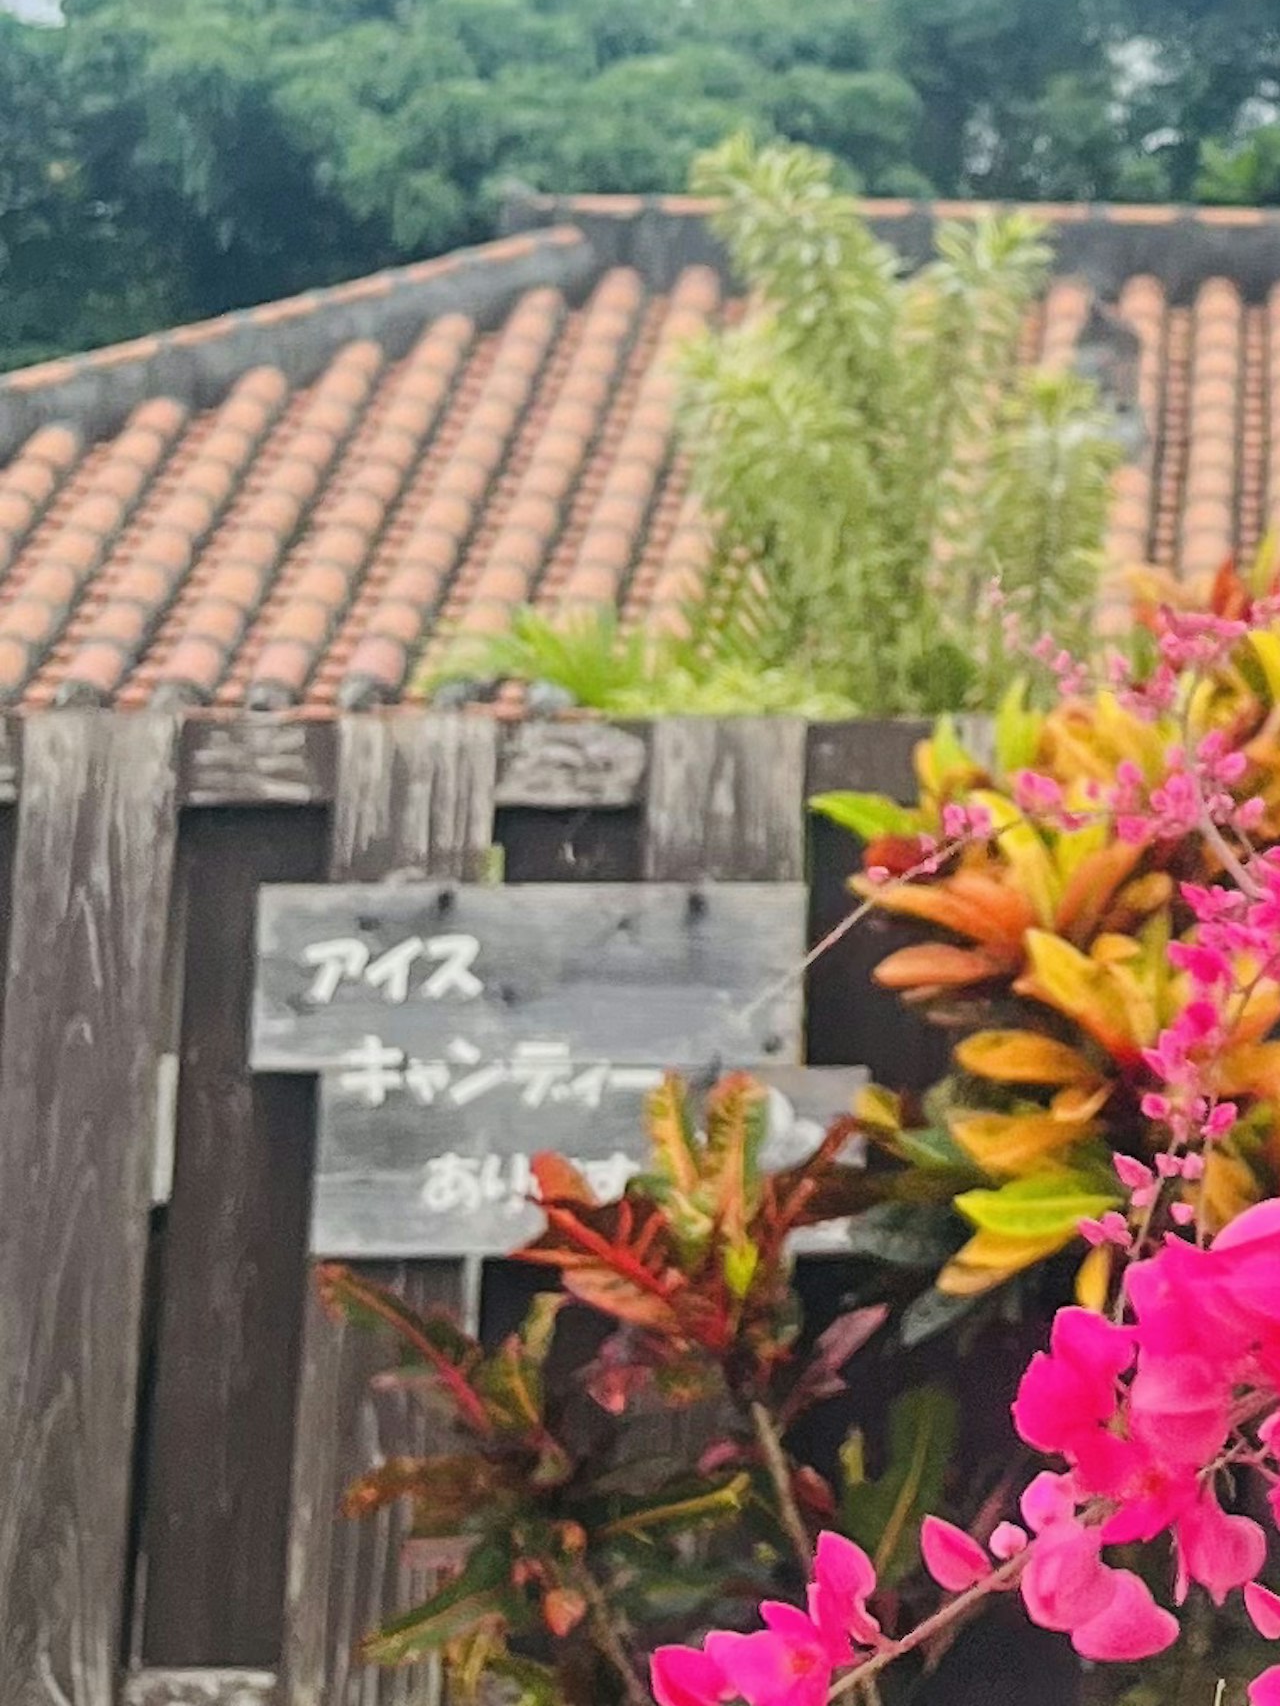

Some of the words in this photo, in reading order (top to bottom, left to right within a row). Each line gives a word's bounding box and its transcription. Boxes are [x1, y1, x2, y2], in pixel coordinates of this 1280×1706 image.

[303, 935, 484, 1003] アイス
[340, 1034, 664, 1108] キャンディー
[421, 1151, 642, 1214] ありす
